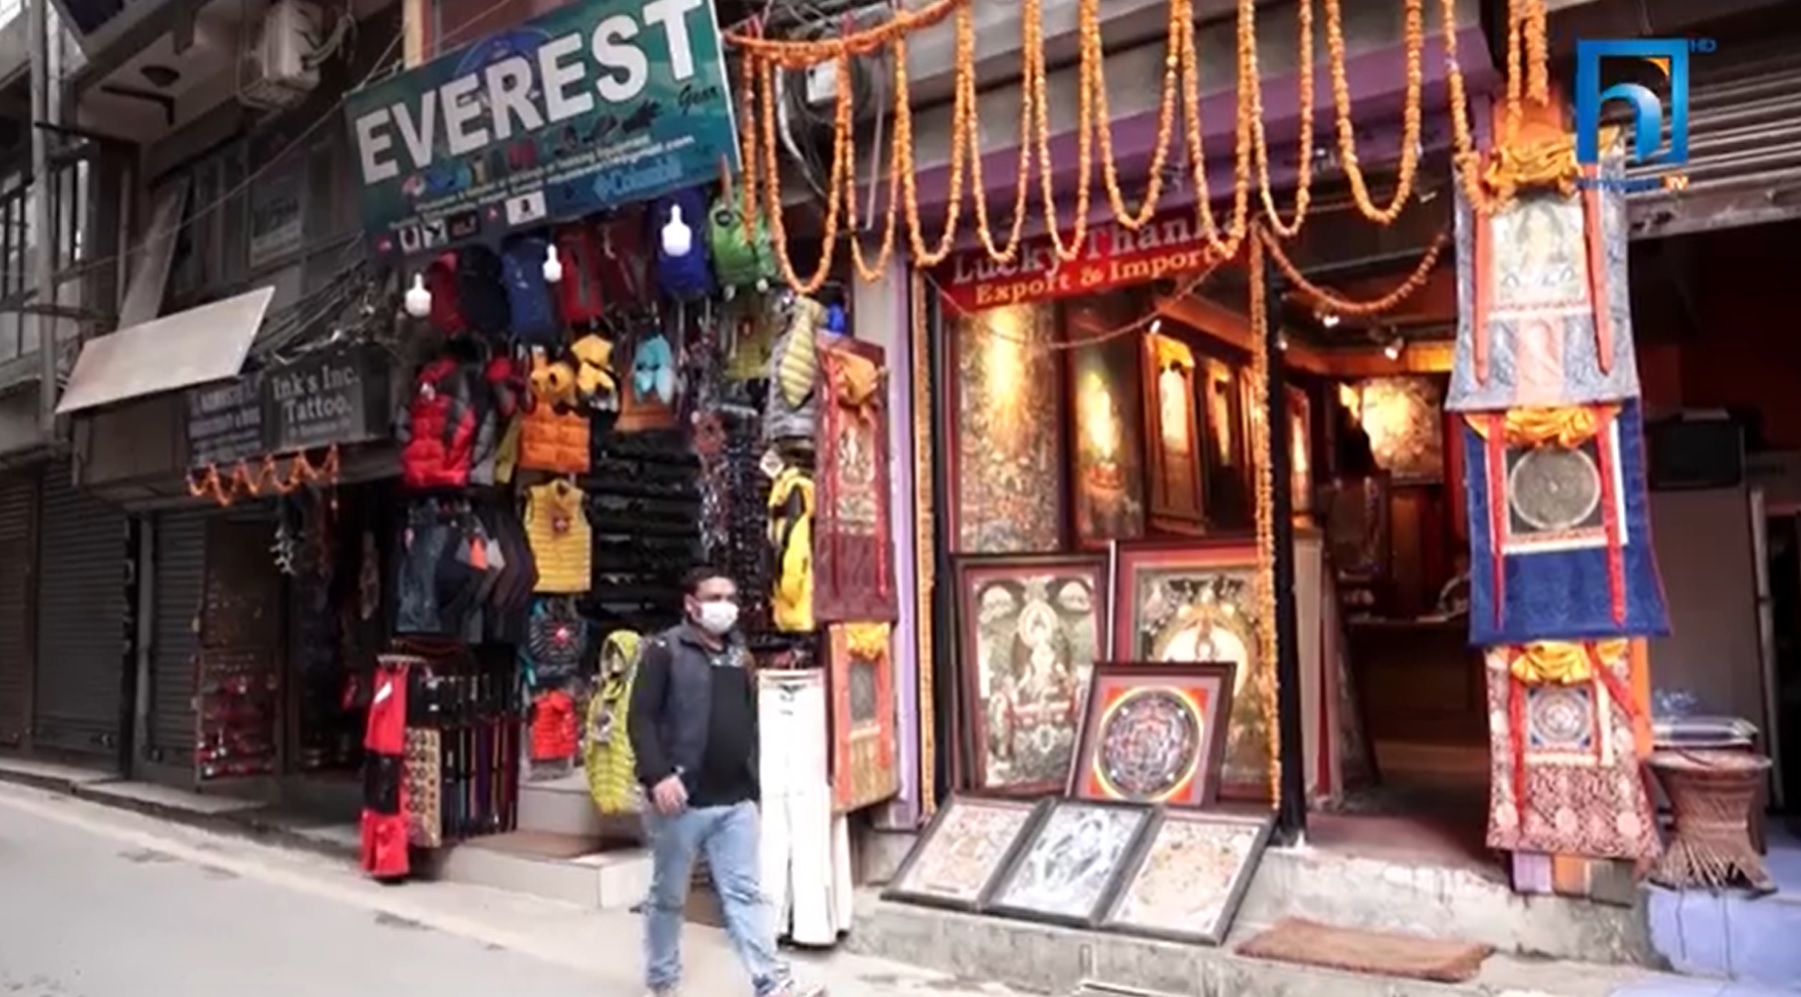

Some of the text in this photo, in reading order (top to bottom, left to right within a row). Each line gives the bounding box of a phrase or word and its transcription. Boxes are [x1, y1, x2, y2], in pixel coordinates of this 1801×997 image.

[355, 0, 704, 185] EVEREST
[953, 243, 1060, 285] Lucky
[975, 247, 1214, 305] Export & Import
[272, 372, 319, 400] Ink's
[322, 365, 360, 390] Inc.
[286, 394, 352, 424] Tattoo.
